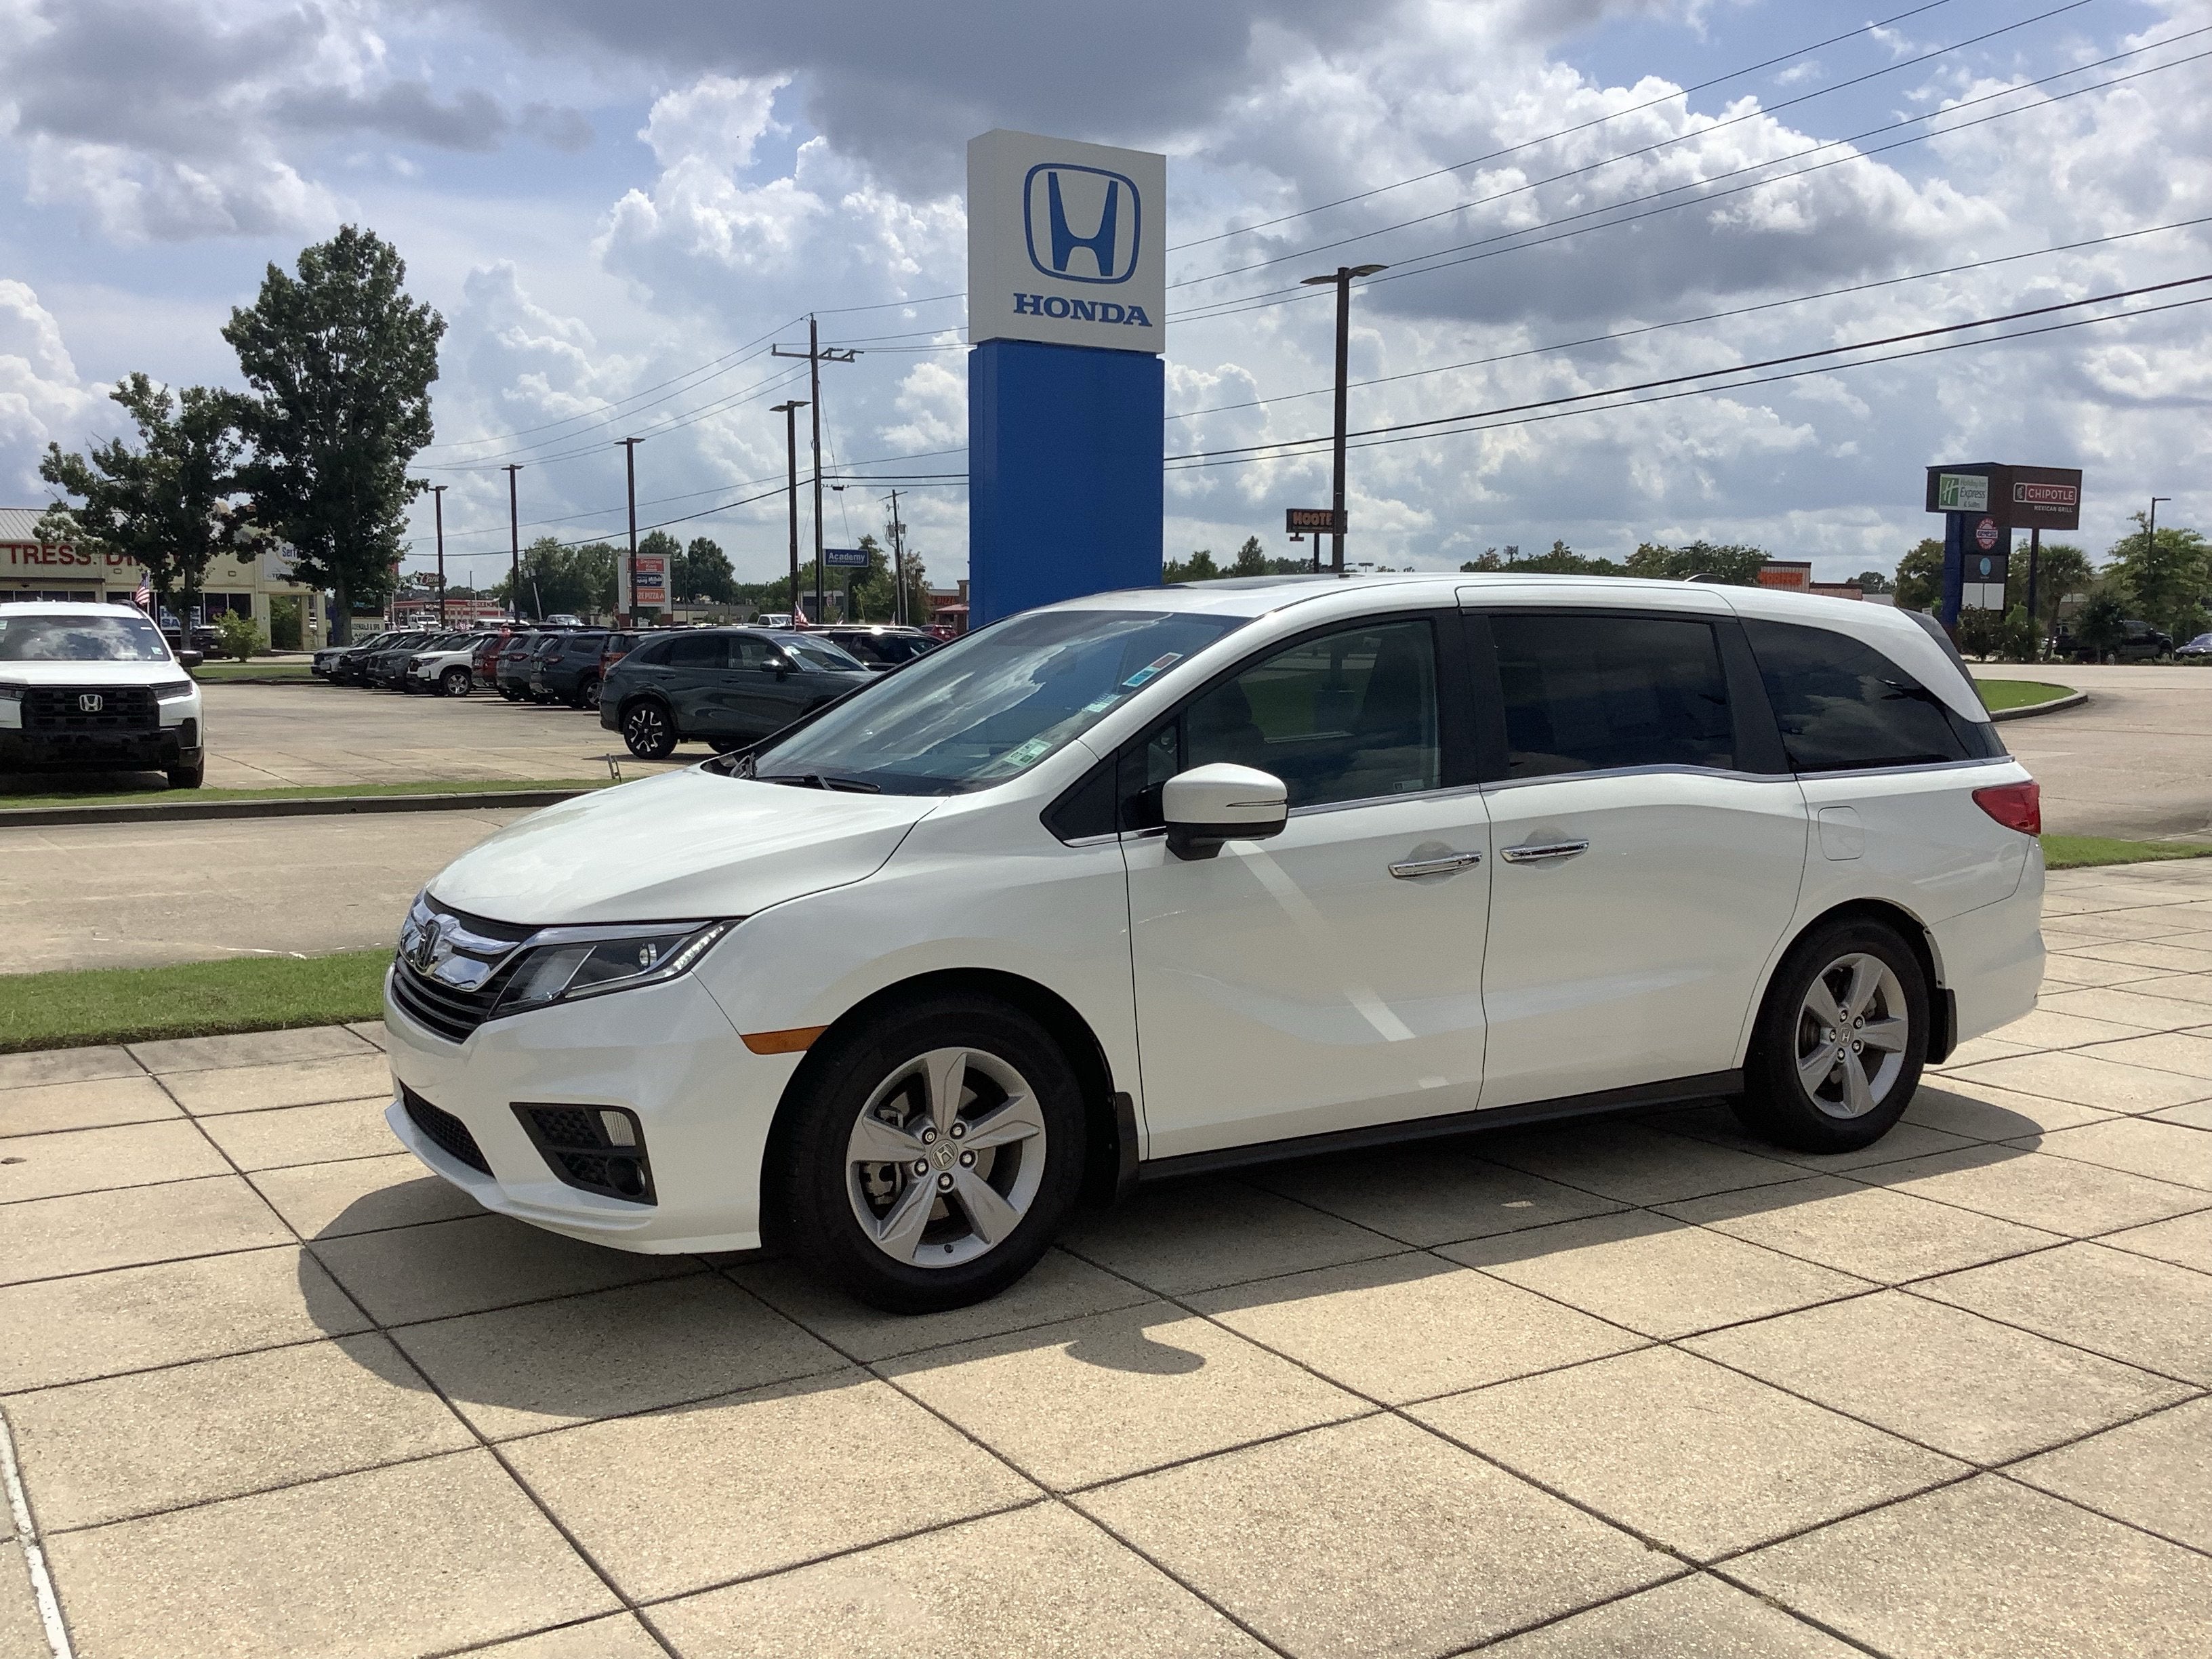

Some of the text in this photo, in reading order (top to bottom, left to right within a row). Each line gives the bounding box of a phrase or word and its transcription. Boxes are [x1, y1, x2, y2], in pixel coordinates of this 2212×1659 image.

[1013, 293, 1152, 327] HONDA
[1960, 487, 1986, 499] Express
[2028, 489, 2074, 500] CHIPOTLE
[1292, 512, 1333, 525] HOOTE
[829, 552, 865, 562] Academy
